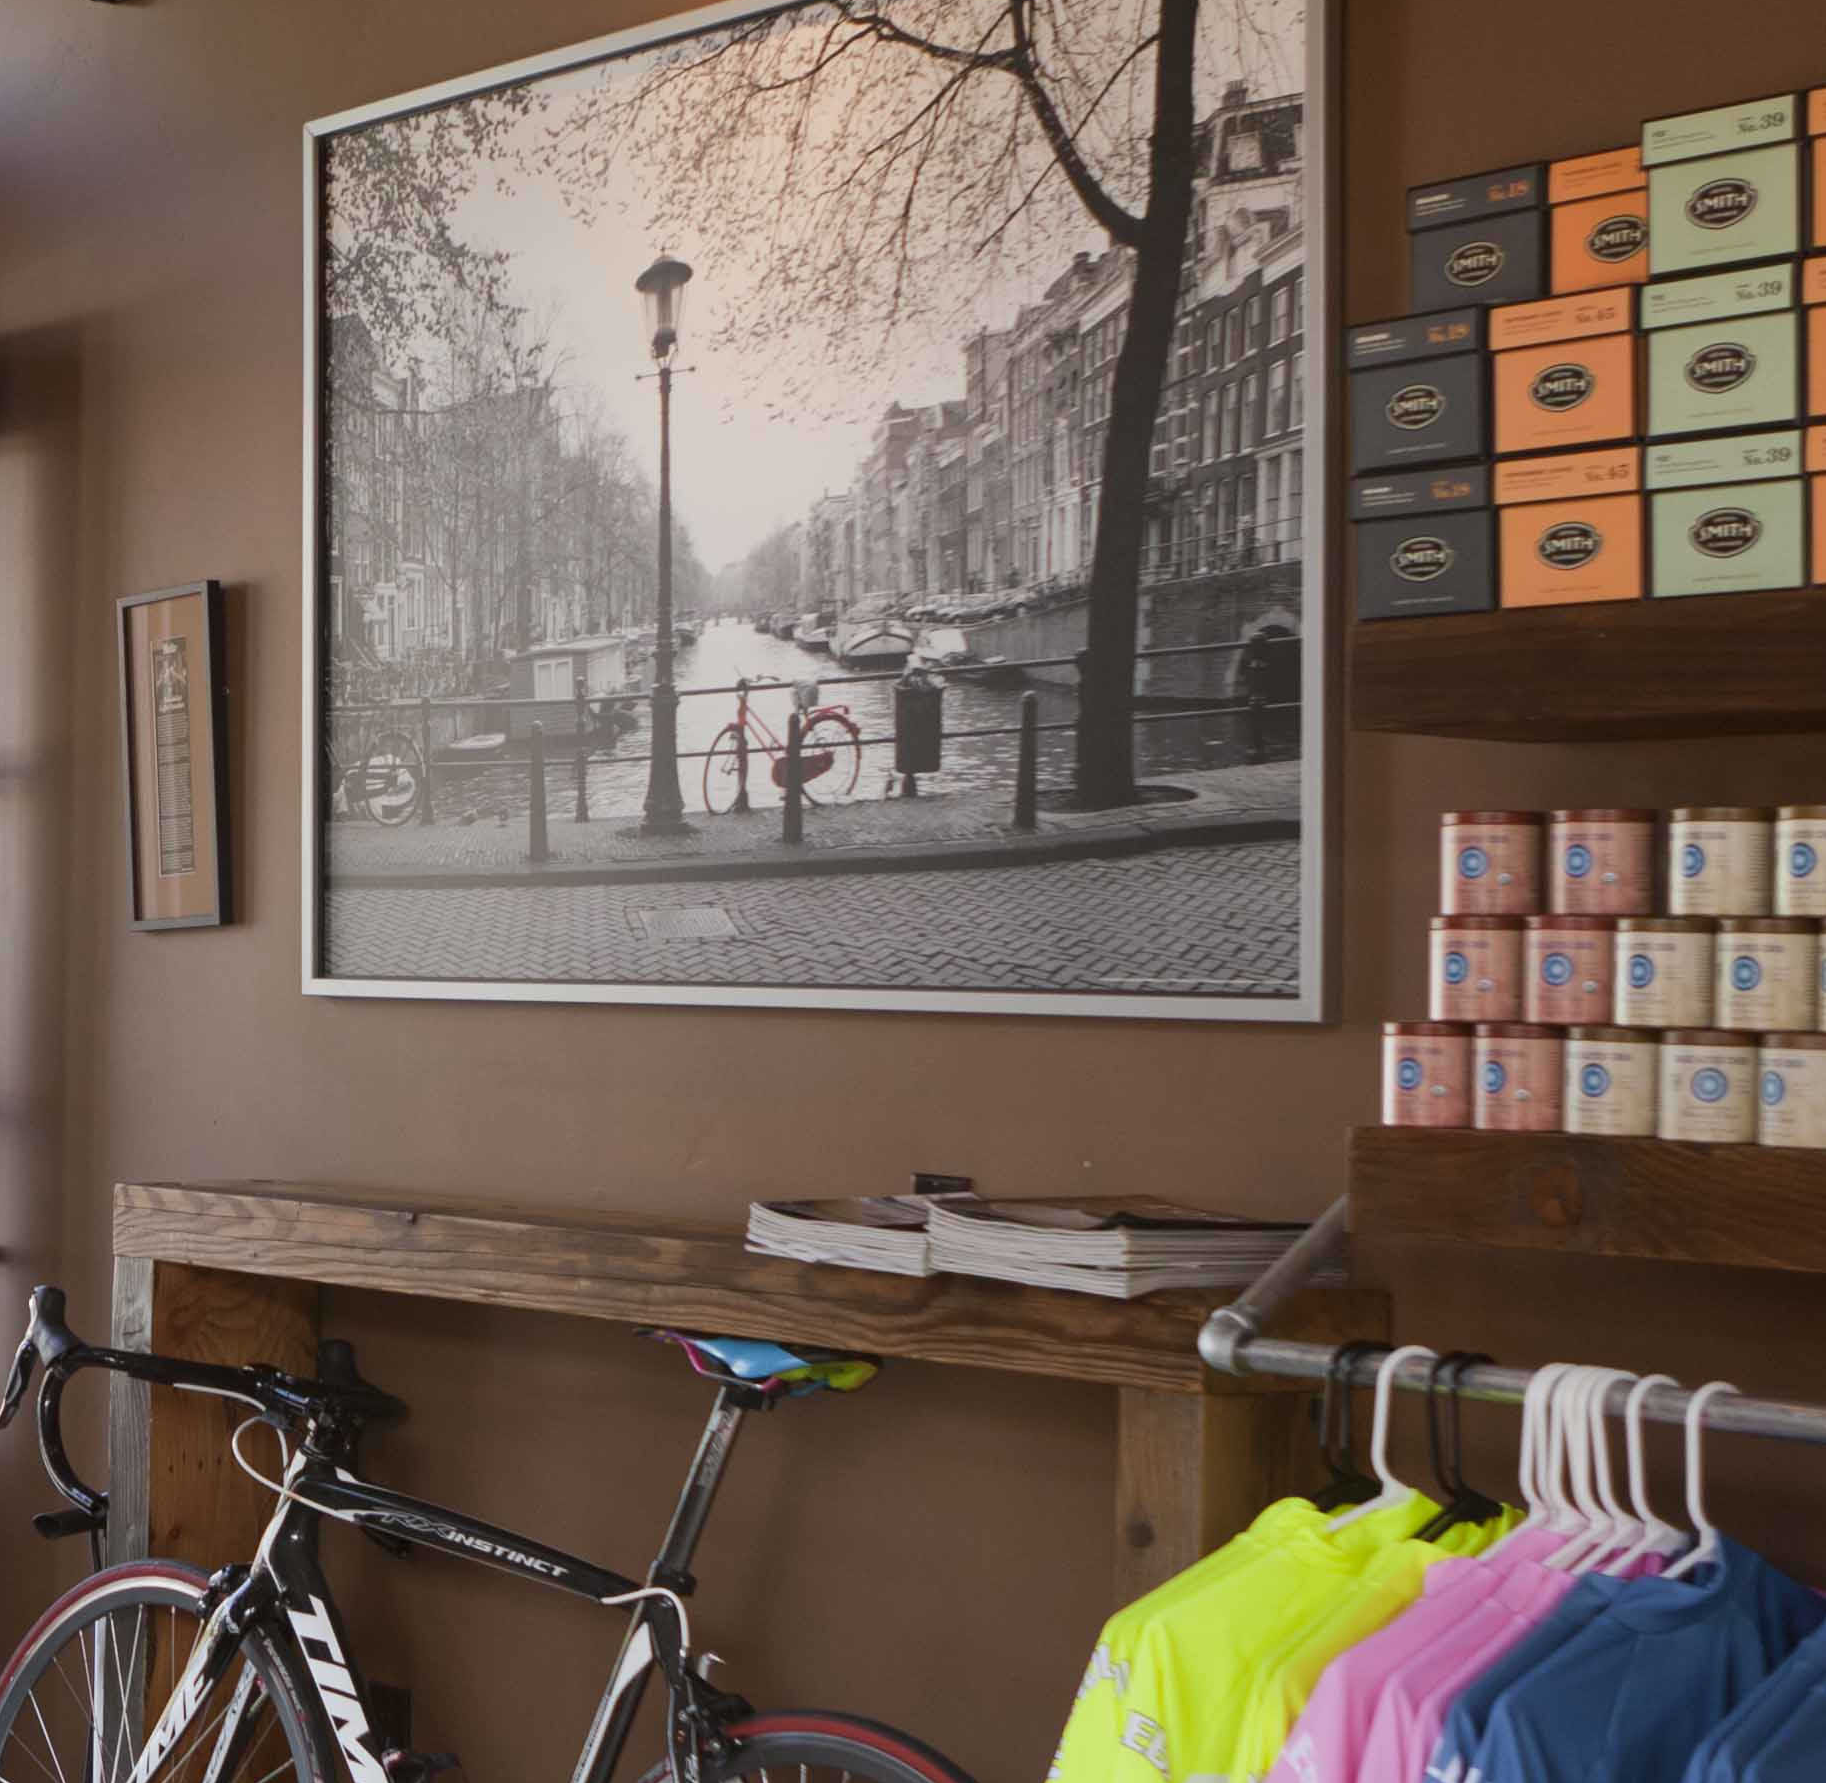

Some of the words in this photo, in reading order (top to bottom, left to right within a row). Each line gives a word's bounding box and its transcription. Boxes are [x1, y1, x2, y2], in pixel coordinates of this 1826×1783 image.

[1694, 192, 1749, 214] SMITH
[1592, 229, 1643, 250] SMITH
[1451, 253, 1499, 274] SMITH
[1693, 357, 1746, 378] SMITH
[1537, 377, 1586, 397] SMITH
[1392, 399, 1438, 416] SMITH
[1698, 522, 1753, 542] SMITH
[1542, 537, 1595, 554] SMITH
[1397, 550, 1446, 567] SMITH
[446, 1529, 570, 1578] INSTINCT
